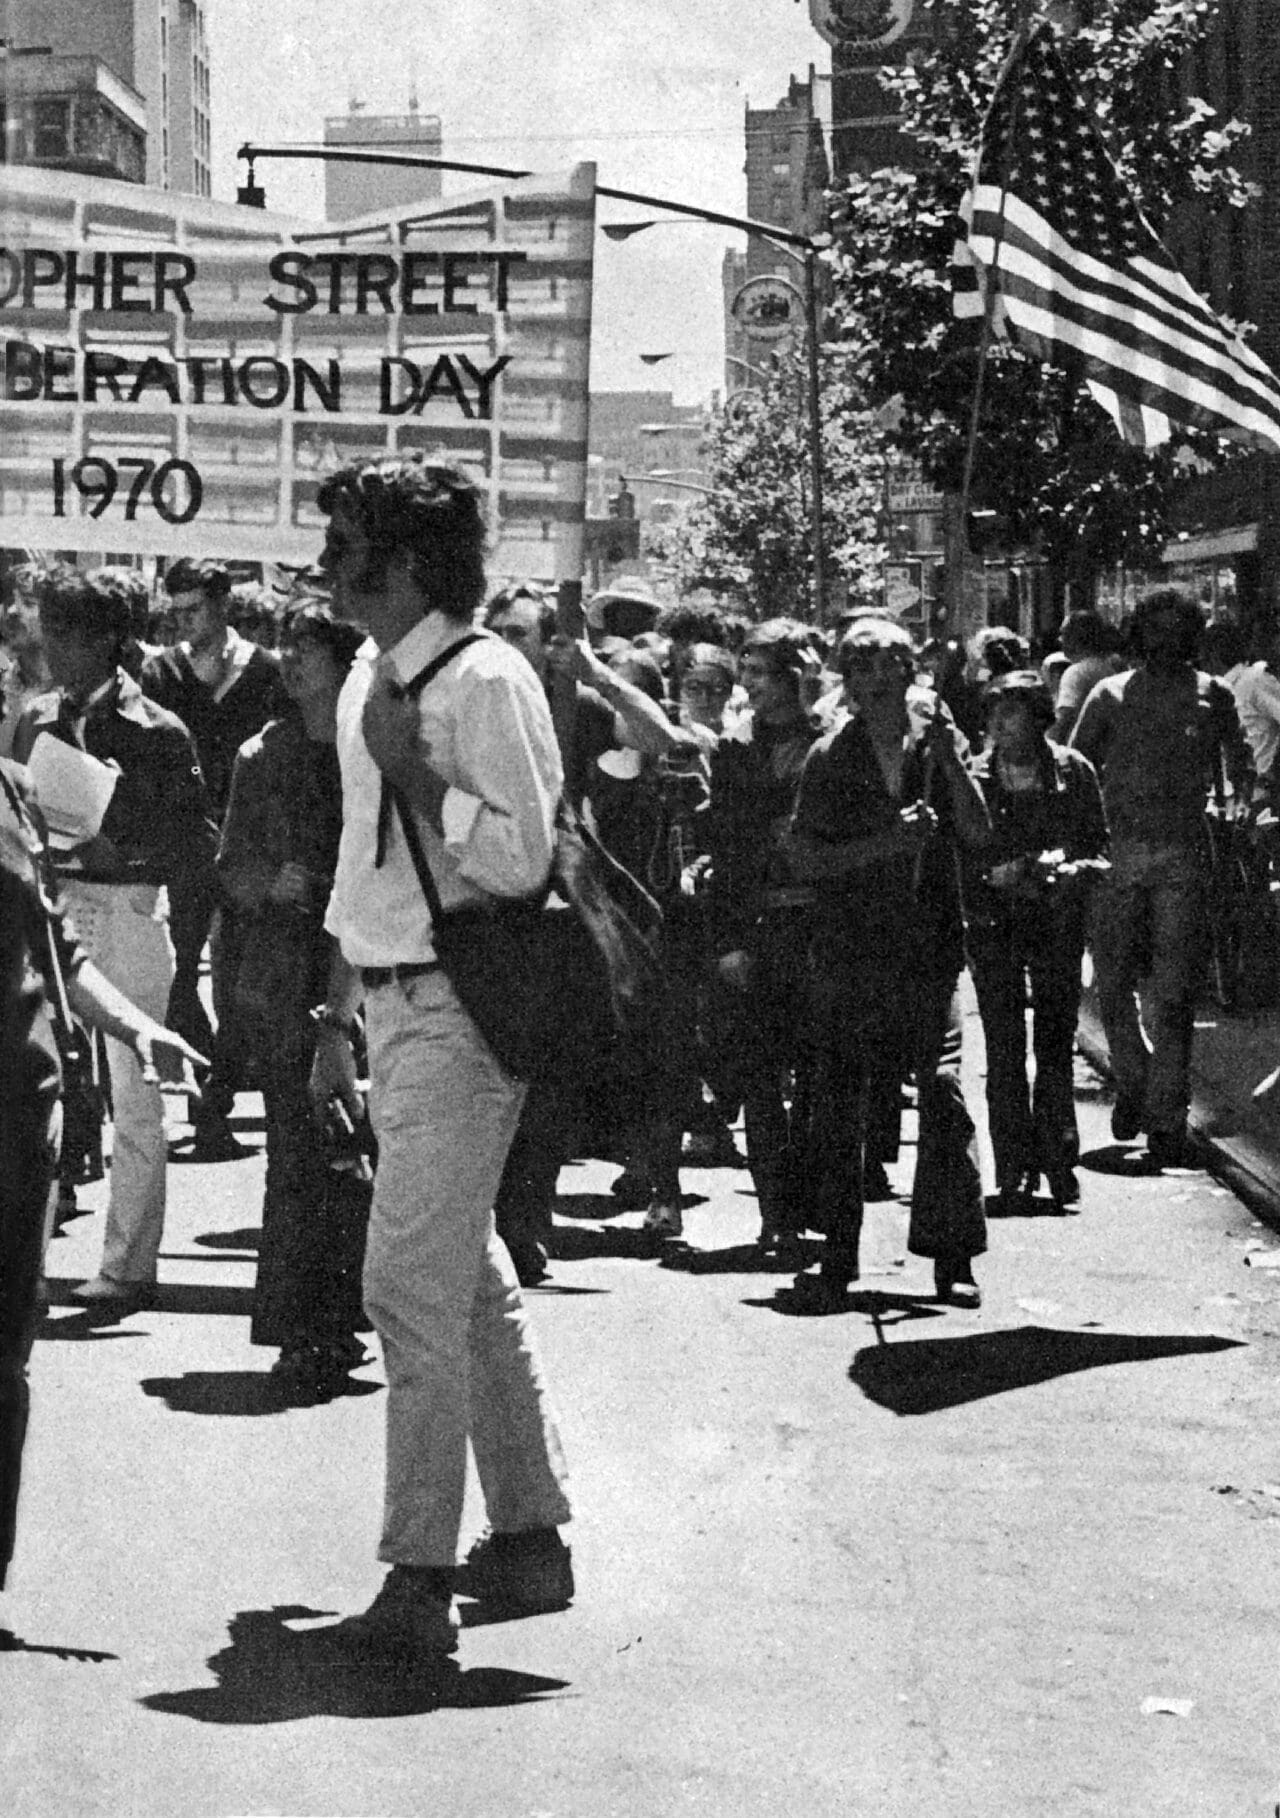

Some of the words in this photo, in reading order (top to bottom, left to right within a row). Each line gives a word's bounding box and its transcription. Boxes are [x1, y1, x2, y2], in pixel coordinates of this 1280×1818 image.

[263, 251, 527, 315] STREET
[378, 353, 513, 420] DAY
[51, 456, 202, 525] 1970
